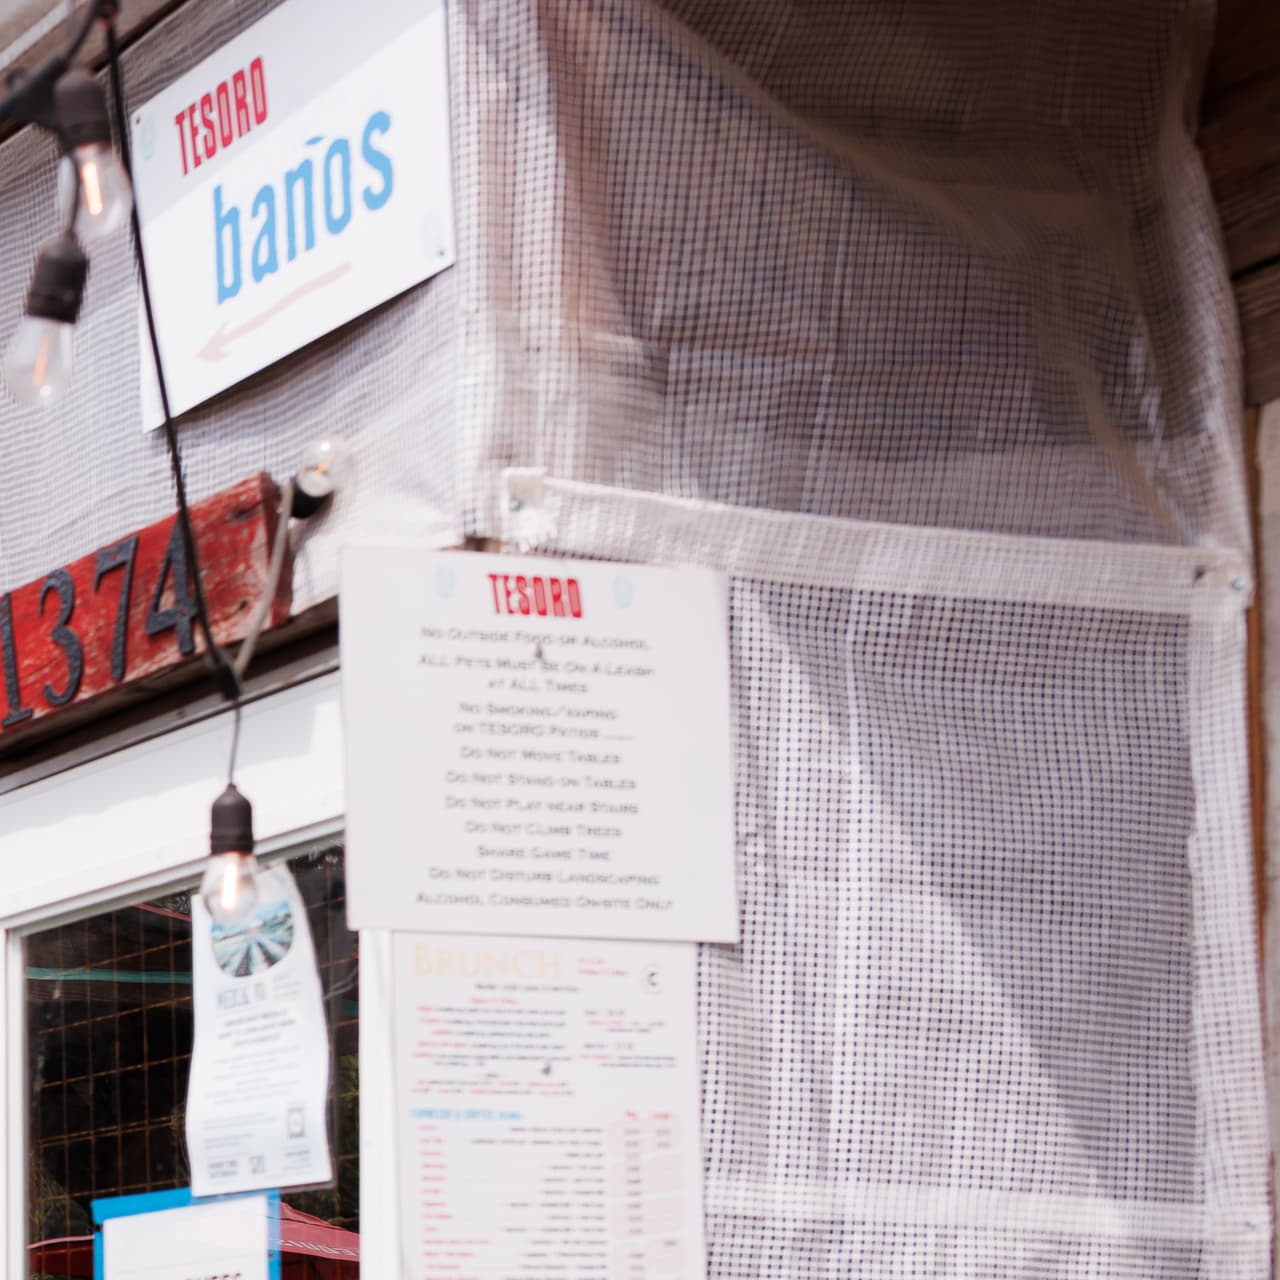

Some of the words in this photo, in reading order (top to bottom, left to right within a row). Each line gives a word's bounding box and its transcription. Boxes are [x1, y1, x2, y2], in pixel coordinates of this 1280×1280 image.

[175, 56, 267, 176] TESORO
[214, 111, 394, 305] baños
[487, 572, 583, 619] TESORO
[411, 943, 561, 978] BRUNCH
